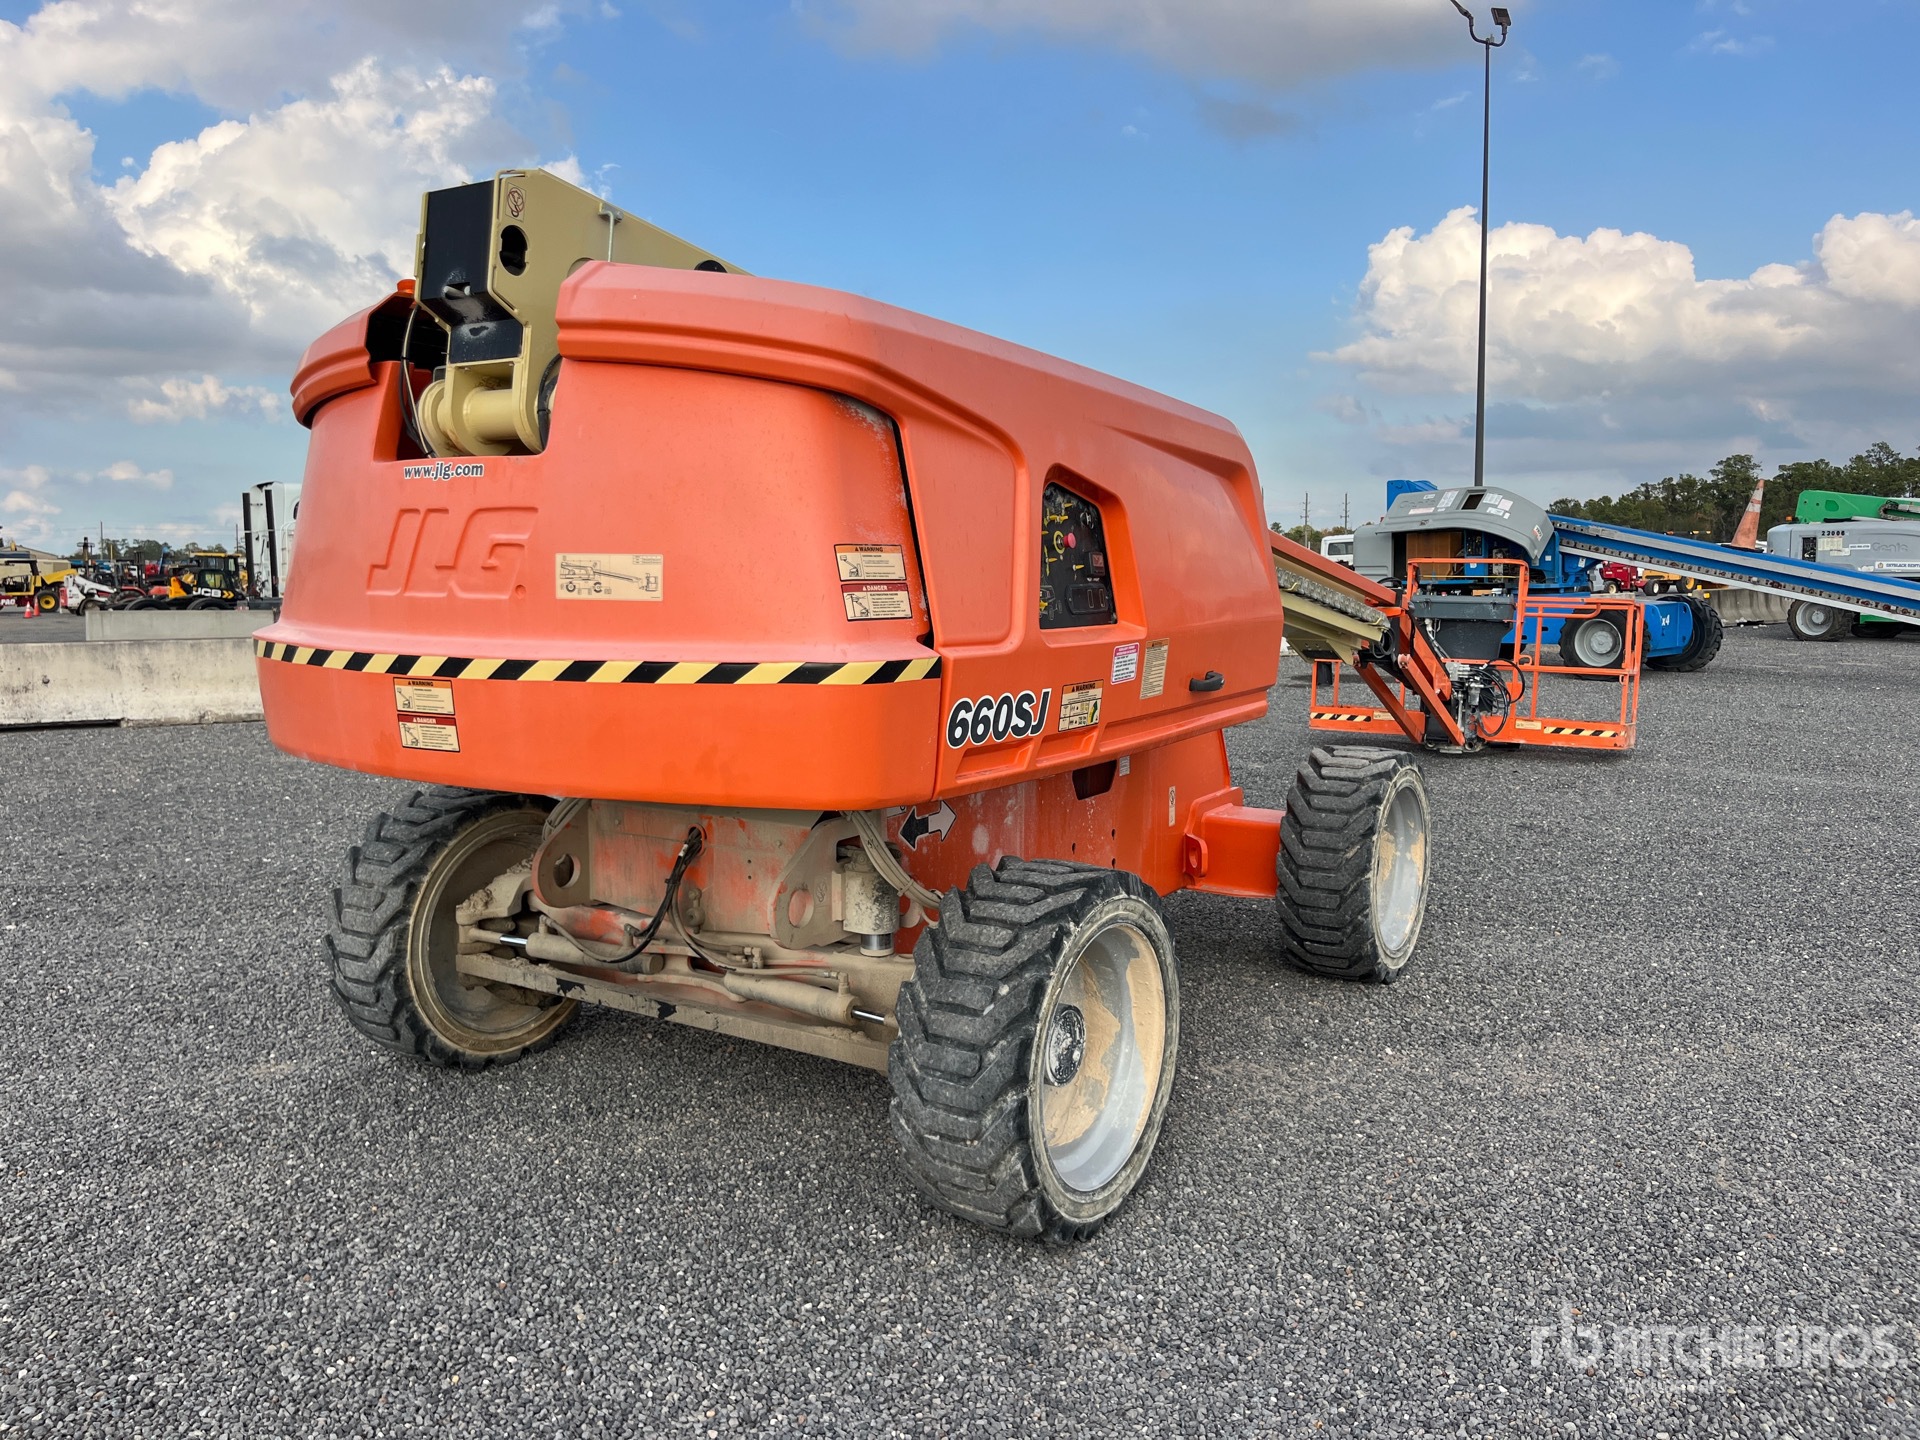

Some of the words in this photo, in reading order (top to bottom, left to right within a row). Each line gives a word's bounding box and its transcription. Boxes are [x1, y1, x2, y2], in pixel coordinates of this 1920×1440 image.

[404, 462, 484, 480] www.jlg.com
[366, 506, 538, 600] JLG
[1872, 542, 1908, 551] Genie
[193, 587, 222, 598] JCB
[1076, 682, 1096, 692] WARNING
[946, 688, 1052, 749] 660SJ
